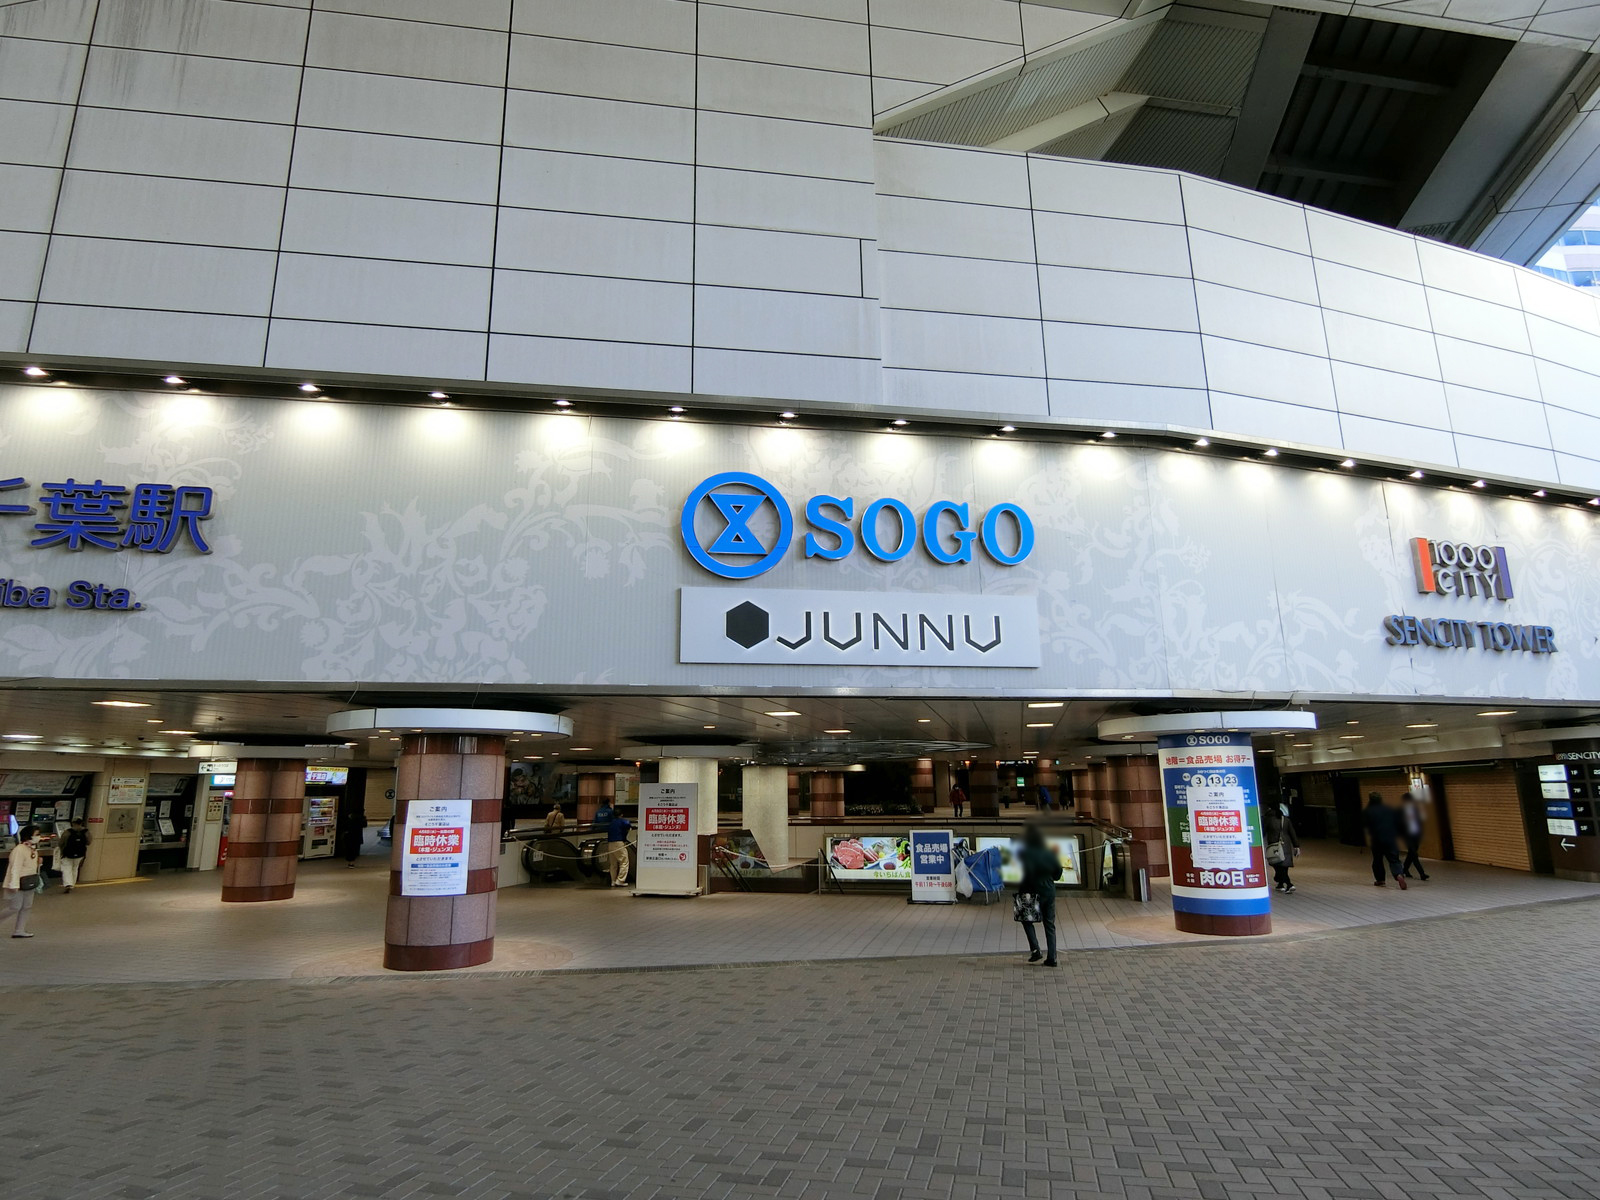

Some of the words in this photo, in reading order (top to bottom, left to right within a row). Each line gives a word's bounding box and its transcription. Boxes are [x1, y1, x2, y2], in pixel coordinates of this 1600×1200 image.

[805, 494, 1035, 566] SOGO
[1429, 539, 1496, 571] 1000
[1434, 568, 1498, 600] CITY
[66, 579, 144, 610] Sta.
[775, 611, 1002, 653] JUNNU
[1384, 614, 1477, 650] SENCITY
[1477, 621, 1558, 653] TOWER
[1198, 735, 1231, 744] SOGO
[1195, 777, 1202, 785] 3
[648, 813, 686, 825] 臨時休業
[1198, 816, 1239, 826] 臨時休業
[413, 834, 460, 846] 臨時休業
[915, 843, 949, 853] 食品売場
[920, 854, 945, 864] 営業中
[1199, 870, 1245, 886] 肉の日
